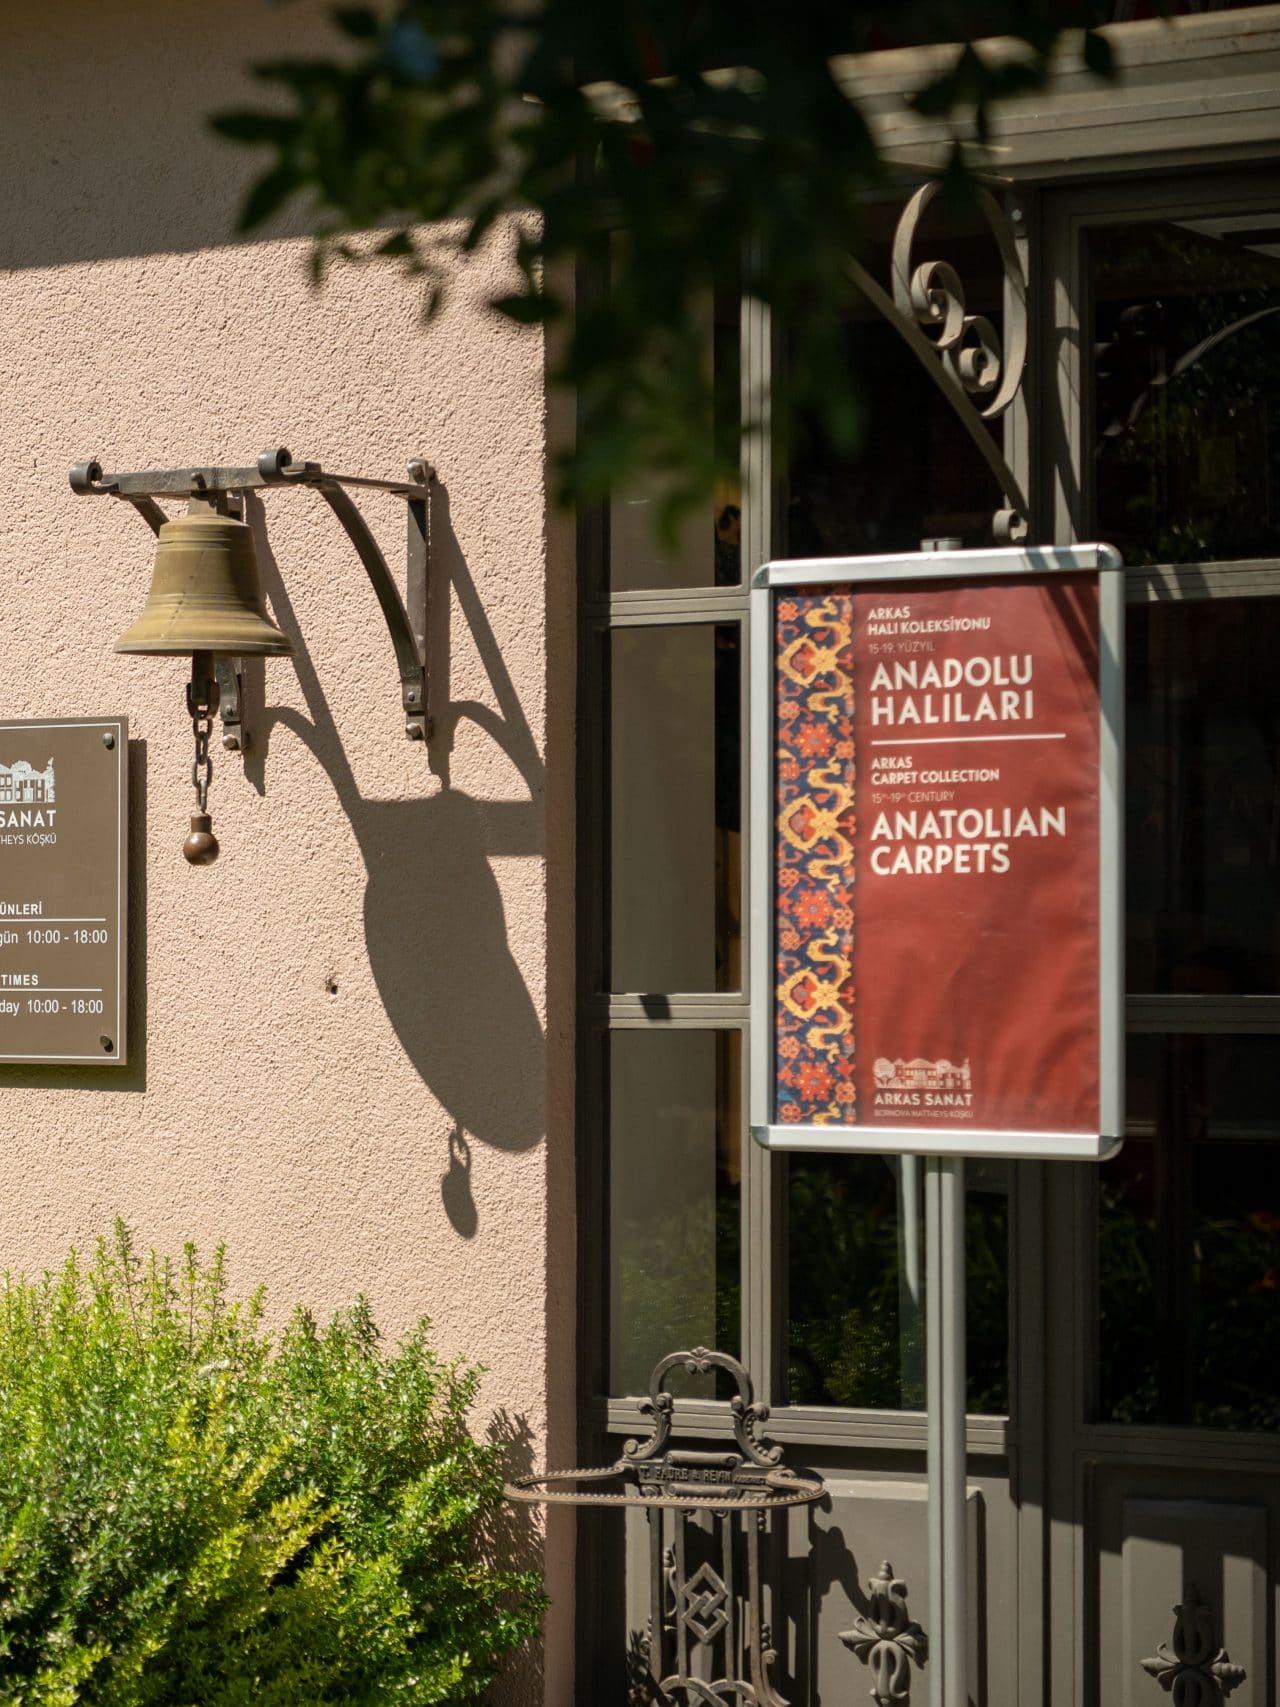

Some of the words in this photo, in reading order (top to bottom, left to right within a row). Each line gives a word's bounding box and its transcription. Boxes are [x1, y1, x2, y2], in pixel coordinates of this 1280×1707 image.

[867, 606, 911, 621] ARKAS
[867, 623, 899, 636] HALI
[901, 616, 991, 634] KOLEKSİYONU
[869, 655, 1033, 691] ANADOLU
[871, 690, 1033, 726] HALILARI
[871, 756, 913, 770] ARKAS
[871, 771, 918, 785] CARPET
[919, 769, 1000, 783] COLLECTION
[908, 791, 955, 803] CENTURY
[870, 806, 1066, 841] ANATOLIAN
[26, 832, 57, 847] KÖŞKÜ
[870, 843, 1011, 876] CARPETS
[26, 930, 61, 944] 10:00
[73, 930, 108, 944] 18:00
[1, 974, 39, 986] TIMES
[27, 1000, 59, 1013] 10:00
[71, 1000, 104, 1013] 18:00
[874, 1093, 921, 1105] ARKAS
[924, 1093, 973, 1106] SANAT
